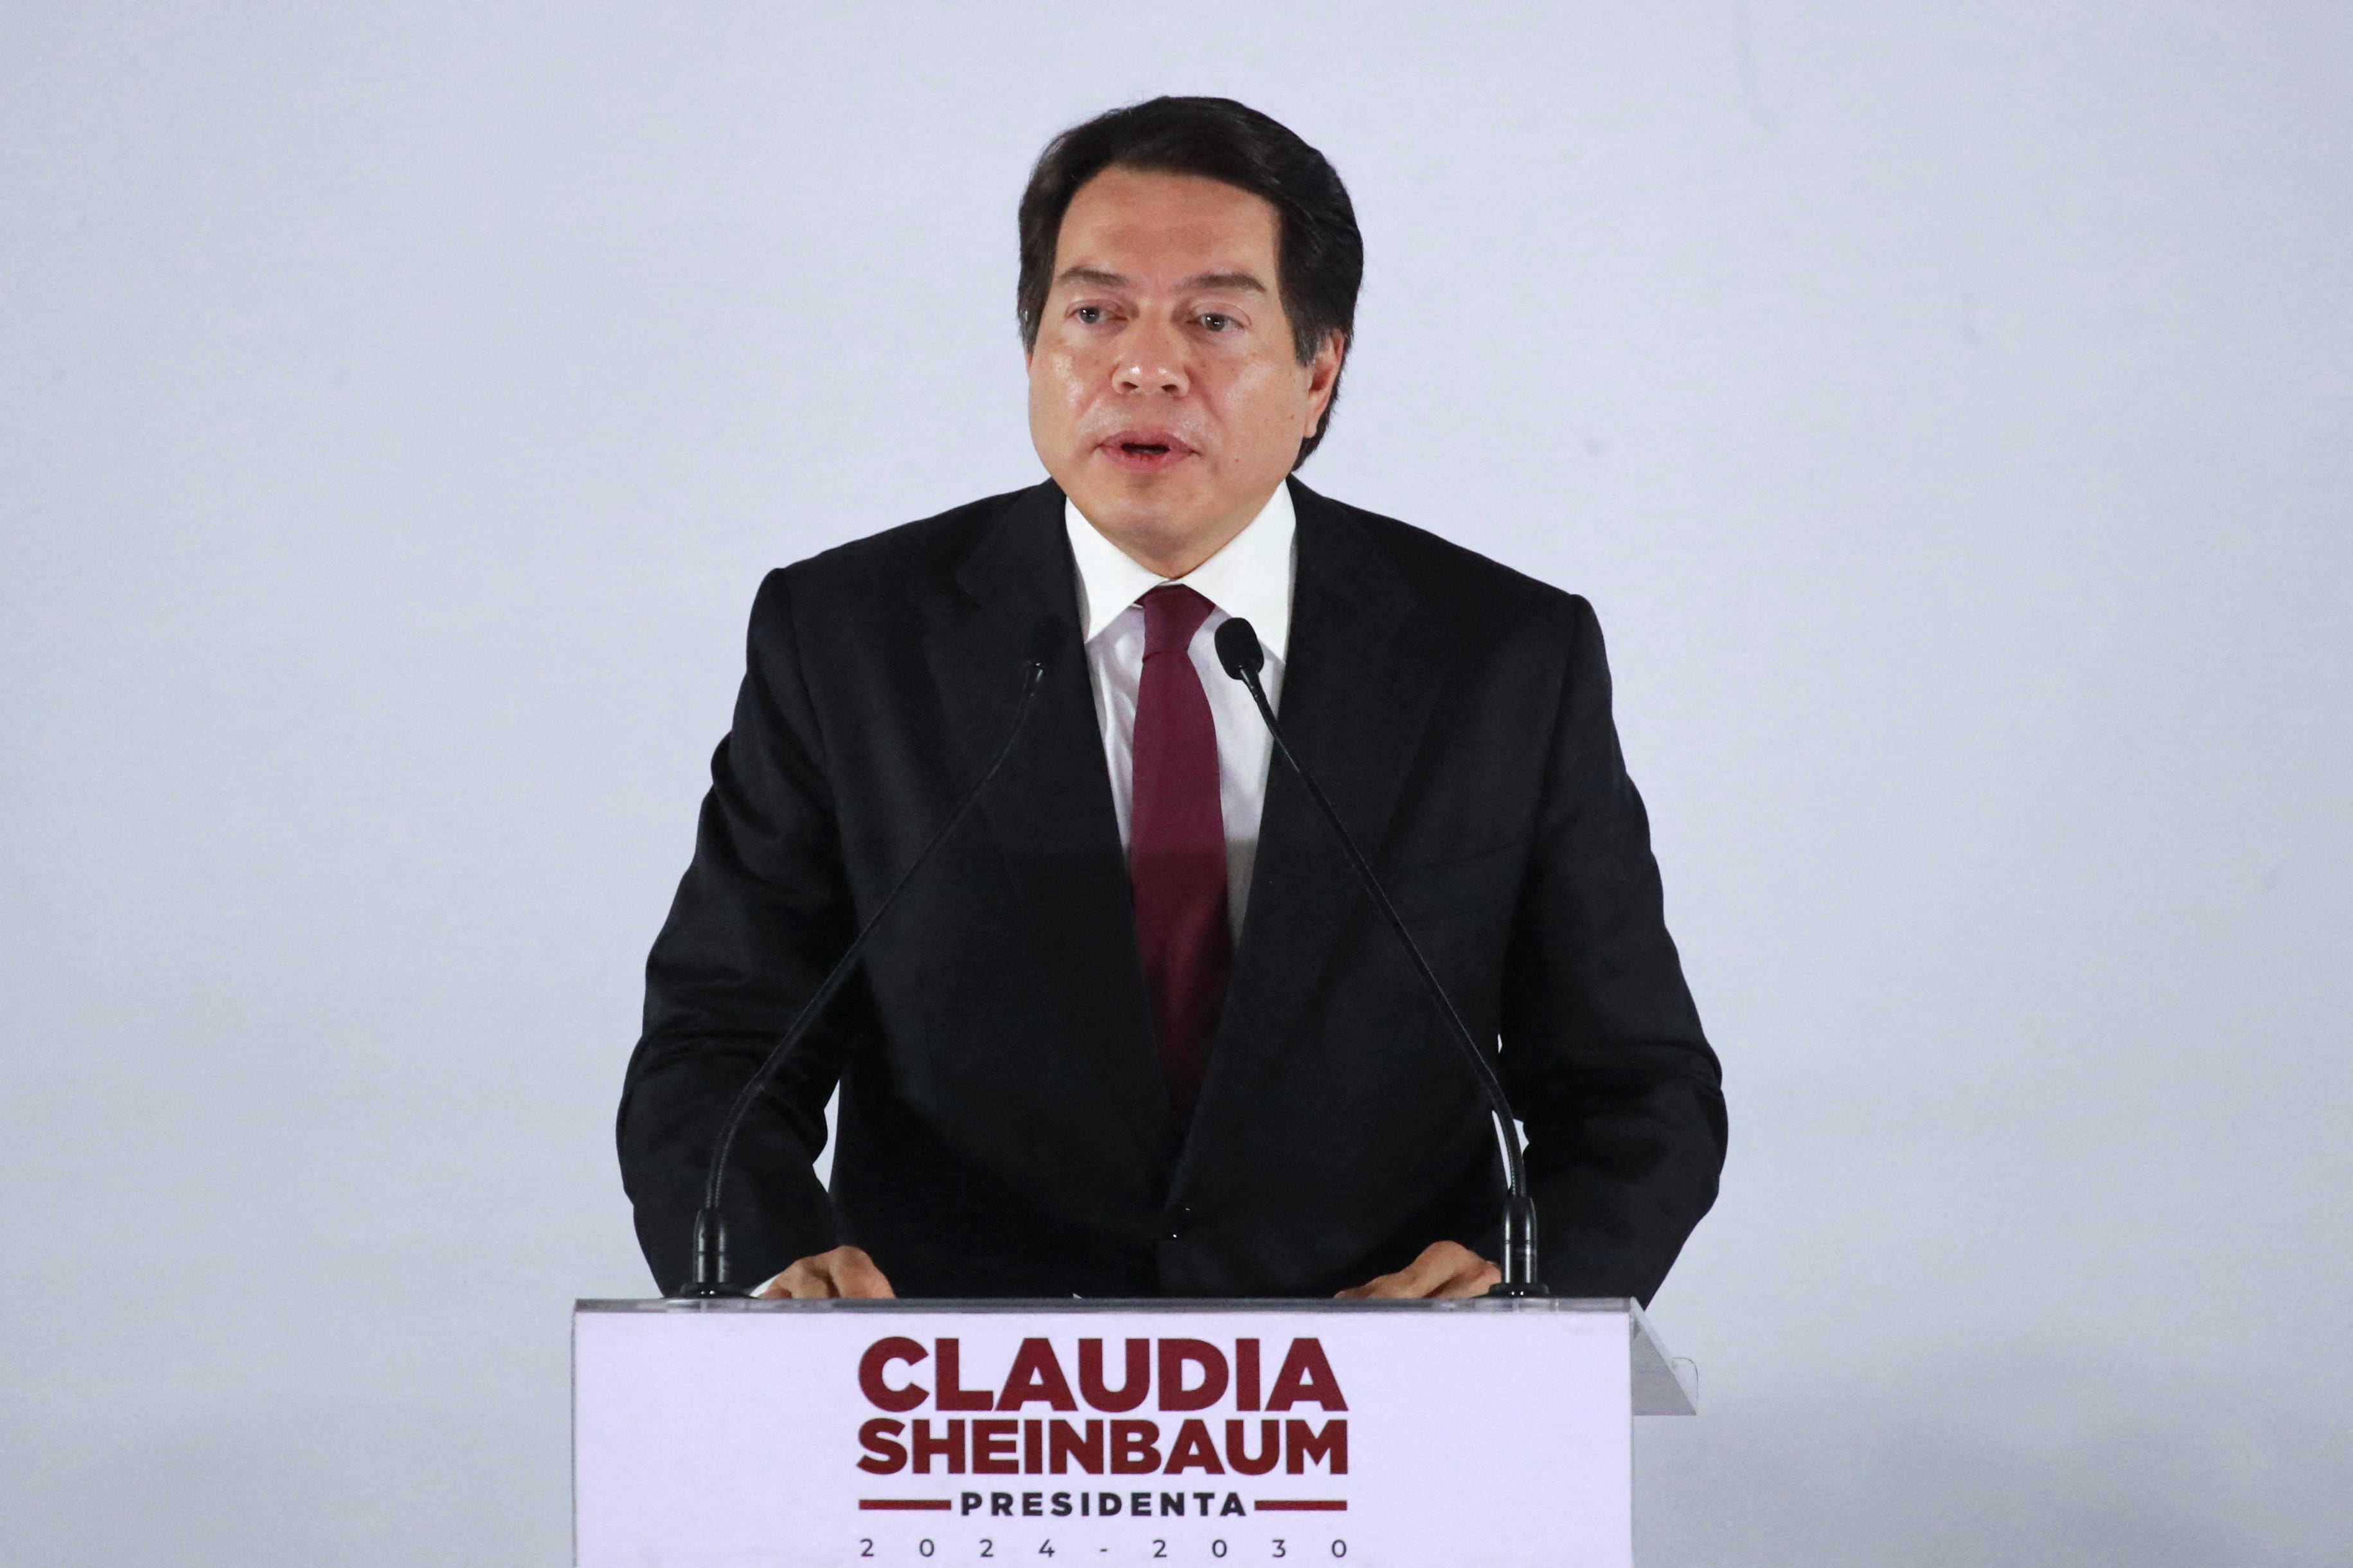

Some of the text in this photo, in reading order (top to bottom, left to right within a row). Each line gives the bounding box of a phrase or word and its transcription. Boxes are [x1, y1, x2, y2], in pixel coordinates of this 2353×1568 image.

[858, 1336, 1349, 1413] CLAUDIA
[857, 1418, 1349, 1476] SHEINBAUM
[961, 1492, 1246, 1517] PRESIDENTA
